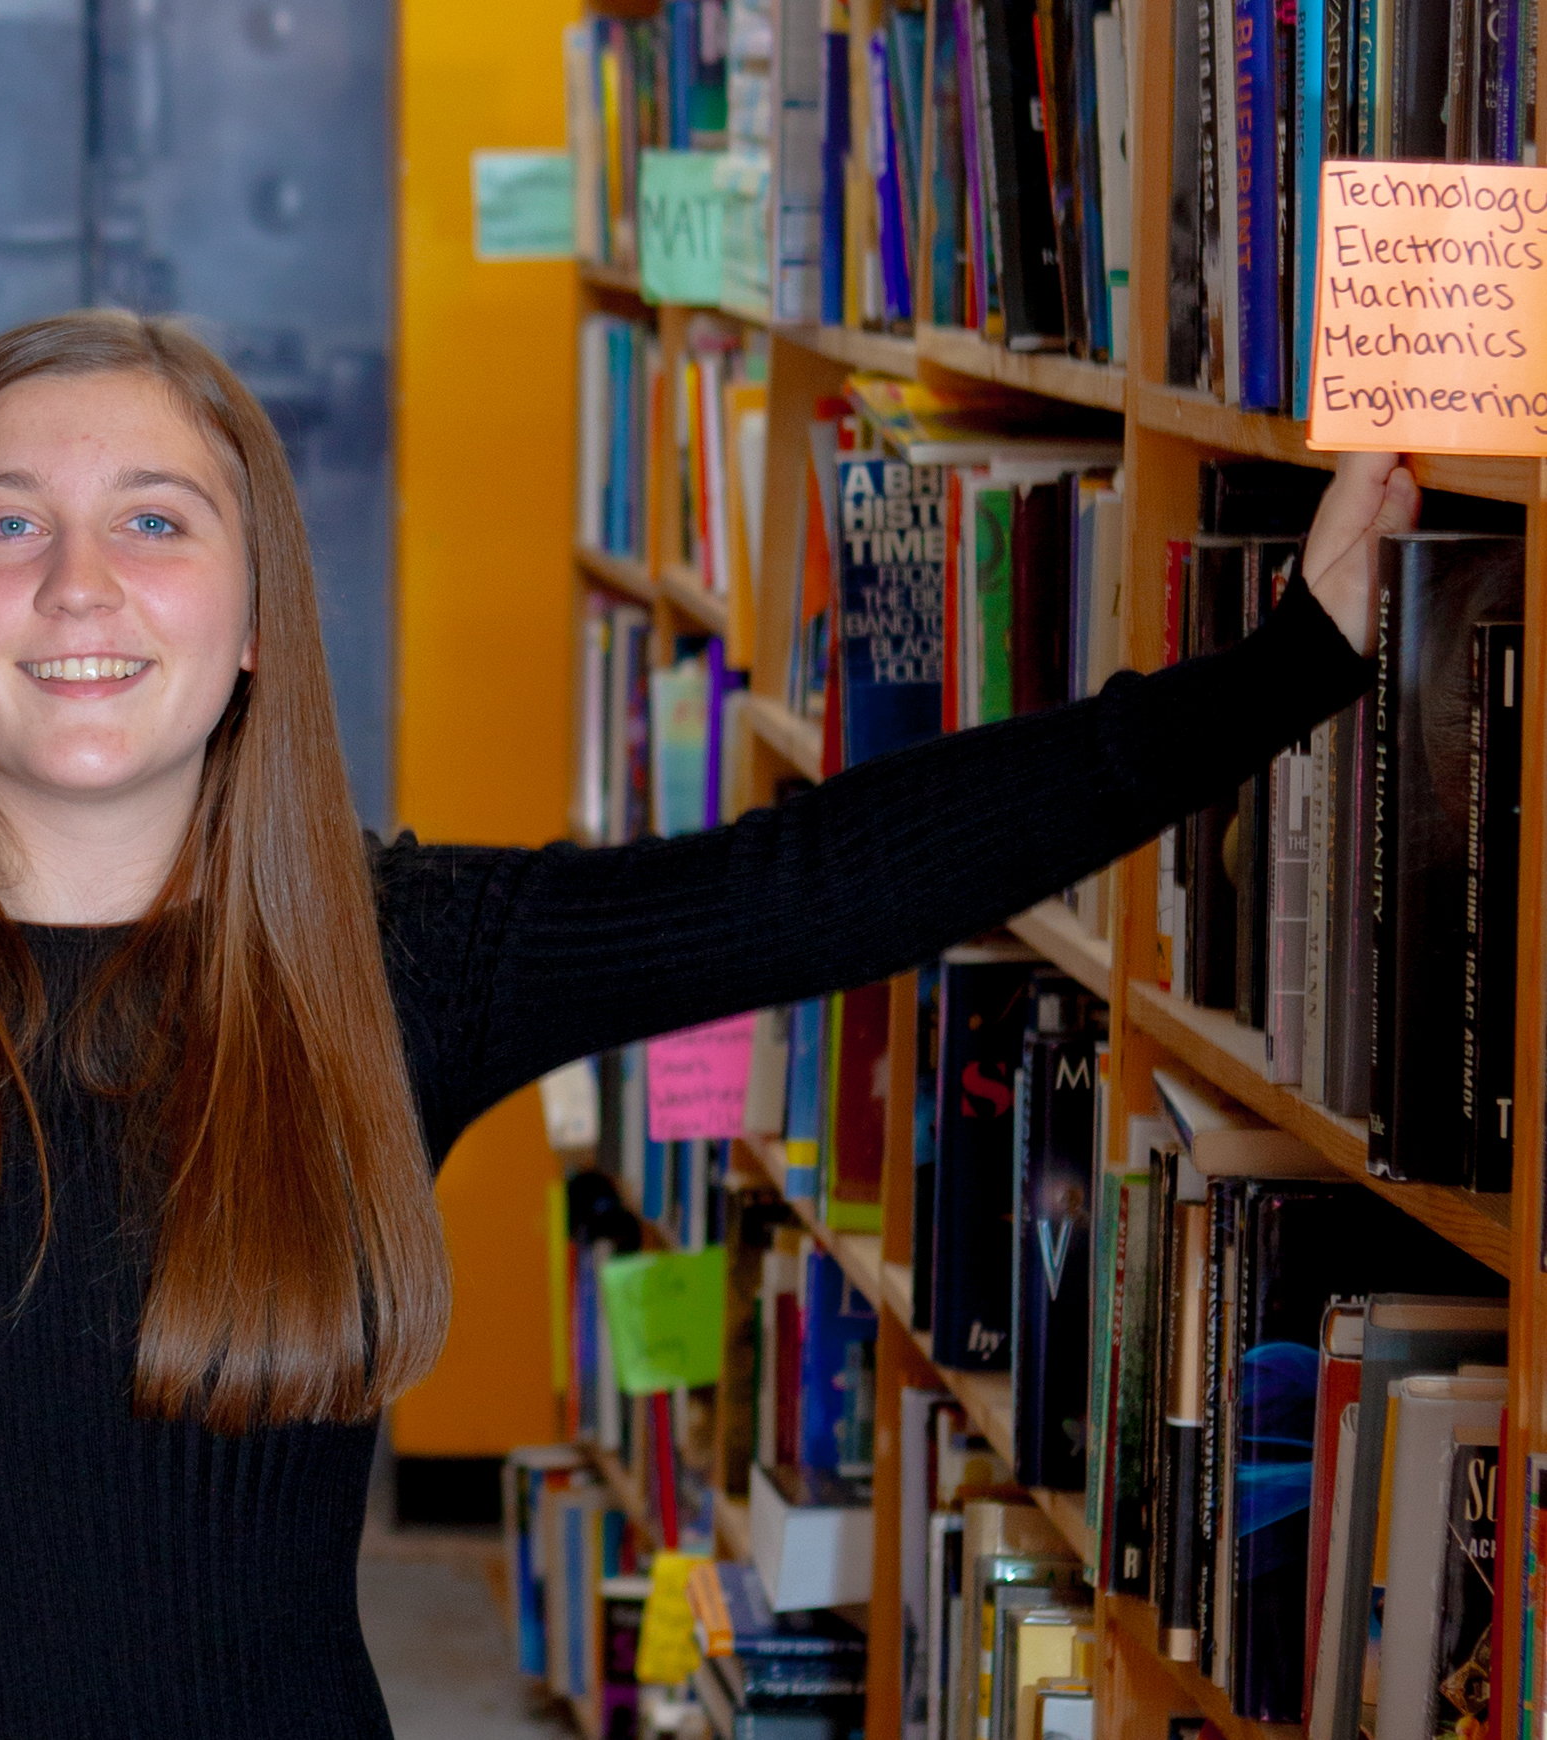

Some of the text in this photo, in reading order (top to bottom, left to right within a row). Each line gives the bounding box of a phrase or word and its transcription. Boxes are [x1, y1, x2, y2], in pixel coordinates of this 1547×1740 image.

[1235, 17, 1253, 271] BLUEPRINT
[1330, 276, 1515, 311] Machines
[1334, 225, 1544, 271] Electronics
[1324, 322, 1528, 359] Mechanics
[844, 466, 876, 497] A
[1375, 587, 1391, 732] SHAPING
[1372, 742, 1387, 925] HUMANITY
[1461, 704, 1482, 1120] THE EXPLODING SUNS ISAAC ASIMOV
